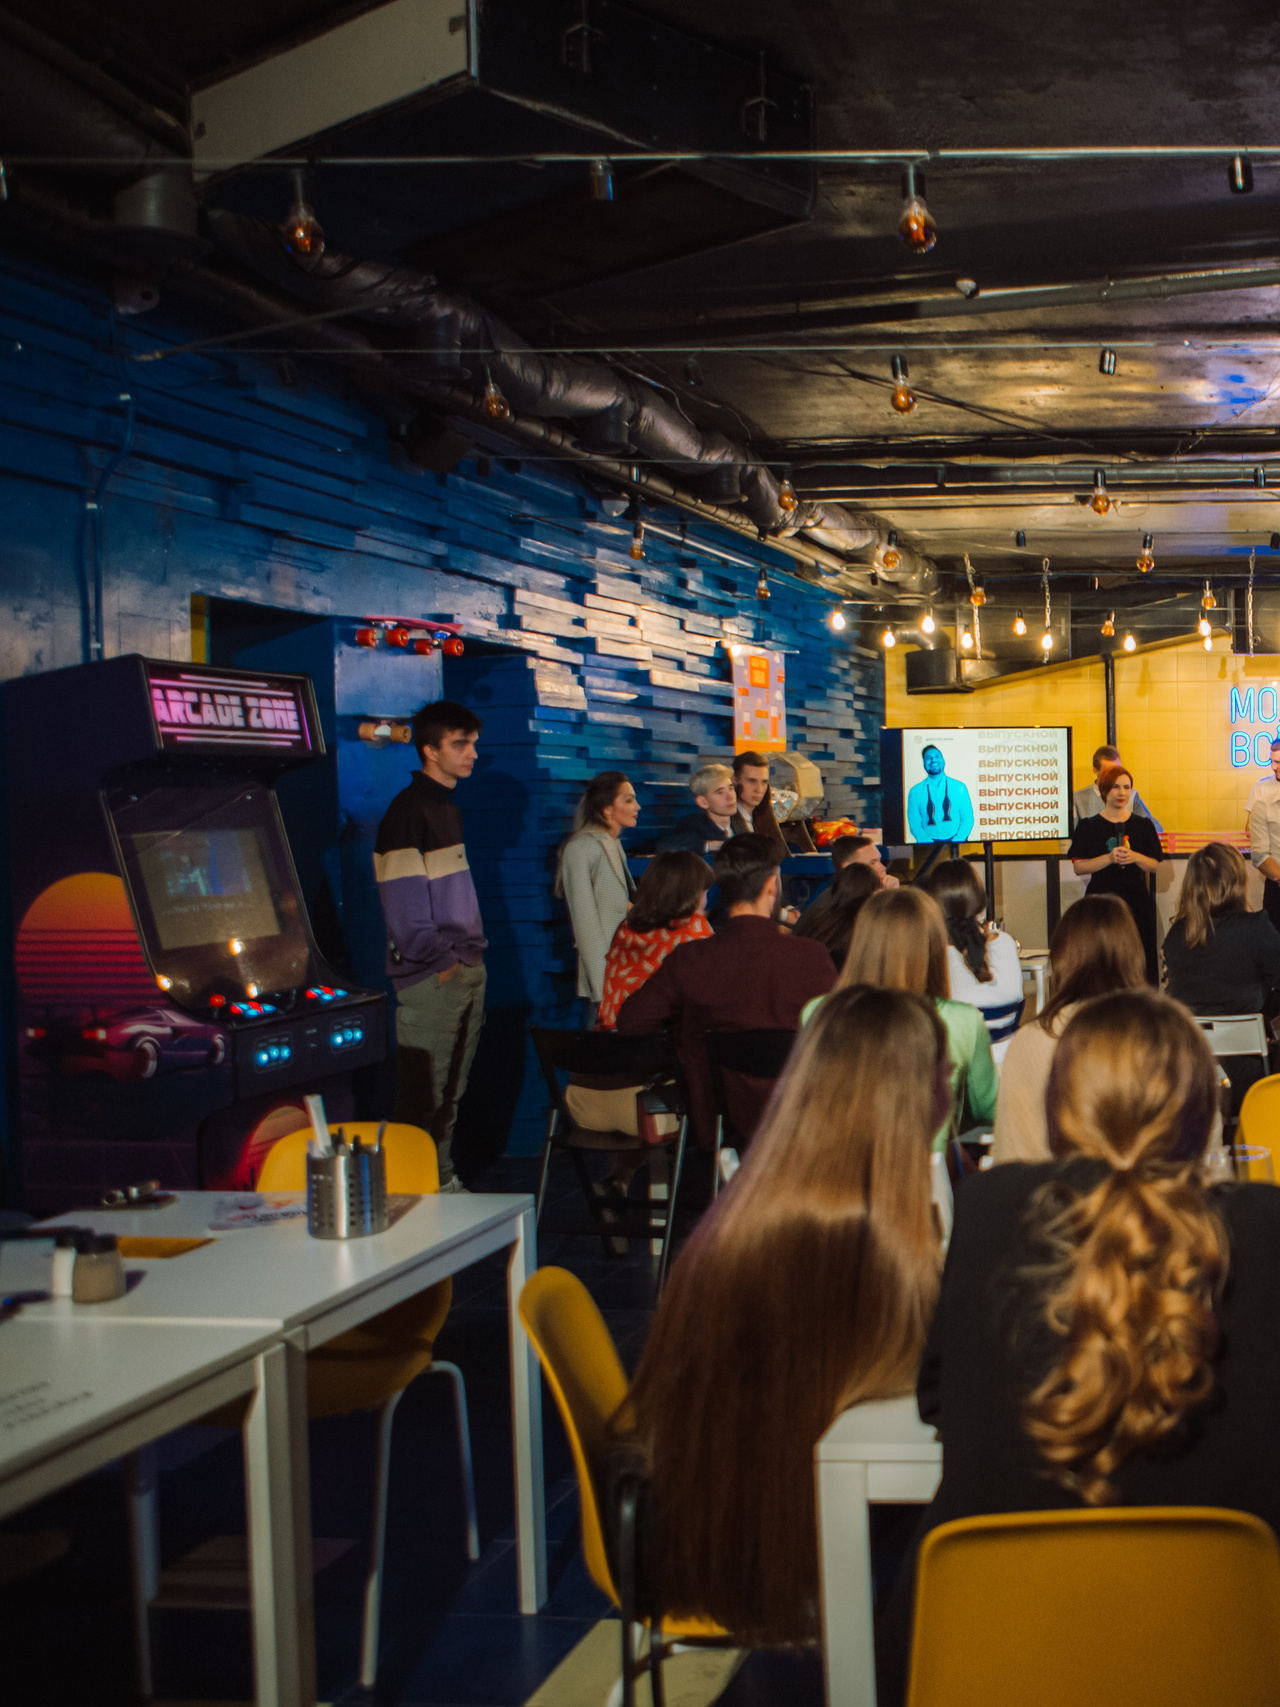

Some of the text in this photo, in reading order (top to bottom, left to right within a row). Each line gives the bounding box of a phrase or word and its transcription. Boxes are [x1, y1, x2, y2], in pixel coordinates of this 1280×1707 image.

[151, 688, 300, 731] ARCADE ZONE
[978, 729, 1058, 739] ВЫПУСКНОЙ
[978, 743, 1058, 753] ВЫПУСКНОЙ
[978, 757, 1058, 768] ВЫПУСКНОЙ
[978, 771, 1059, 782] ВЫПУСКНОЙ
[979, 785, 1059, 797] ВЫПУСКНОЙ
[979, 799, 1059, 811] ВЫПУСКНОЙ
[979, 814, 1059, 826] ВЫПУСКНОЙ
[980, 828, 1059, 840] ВЫПУСКНОЙ
